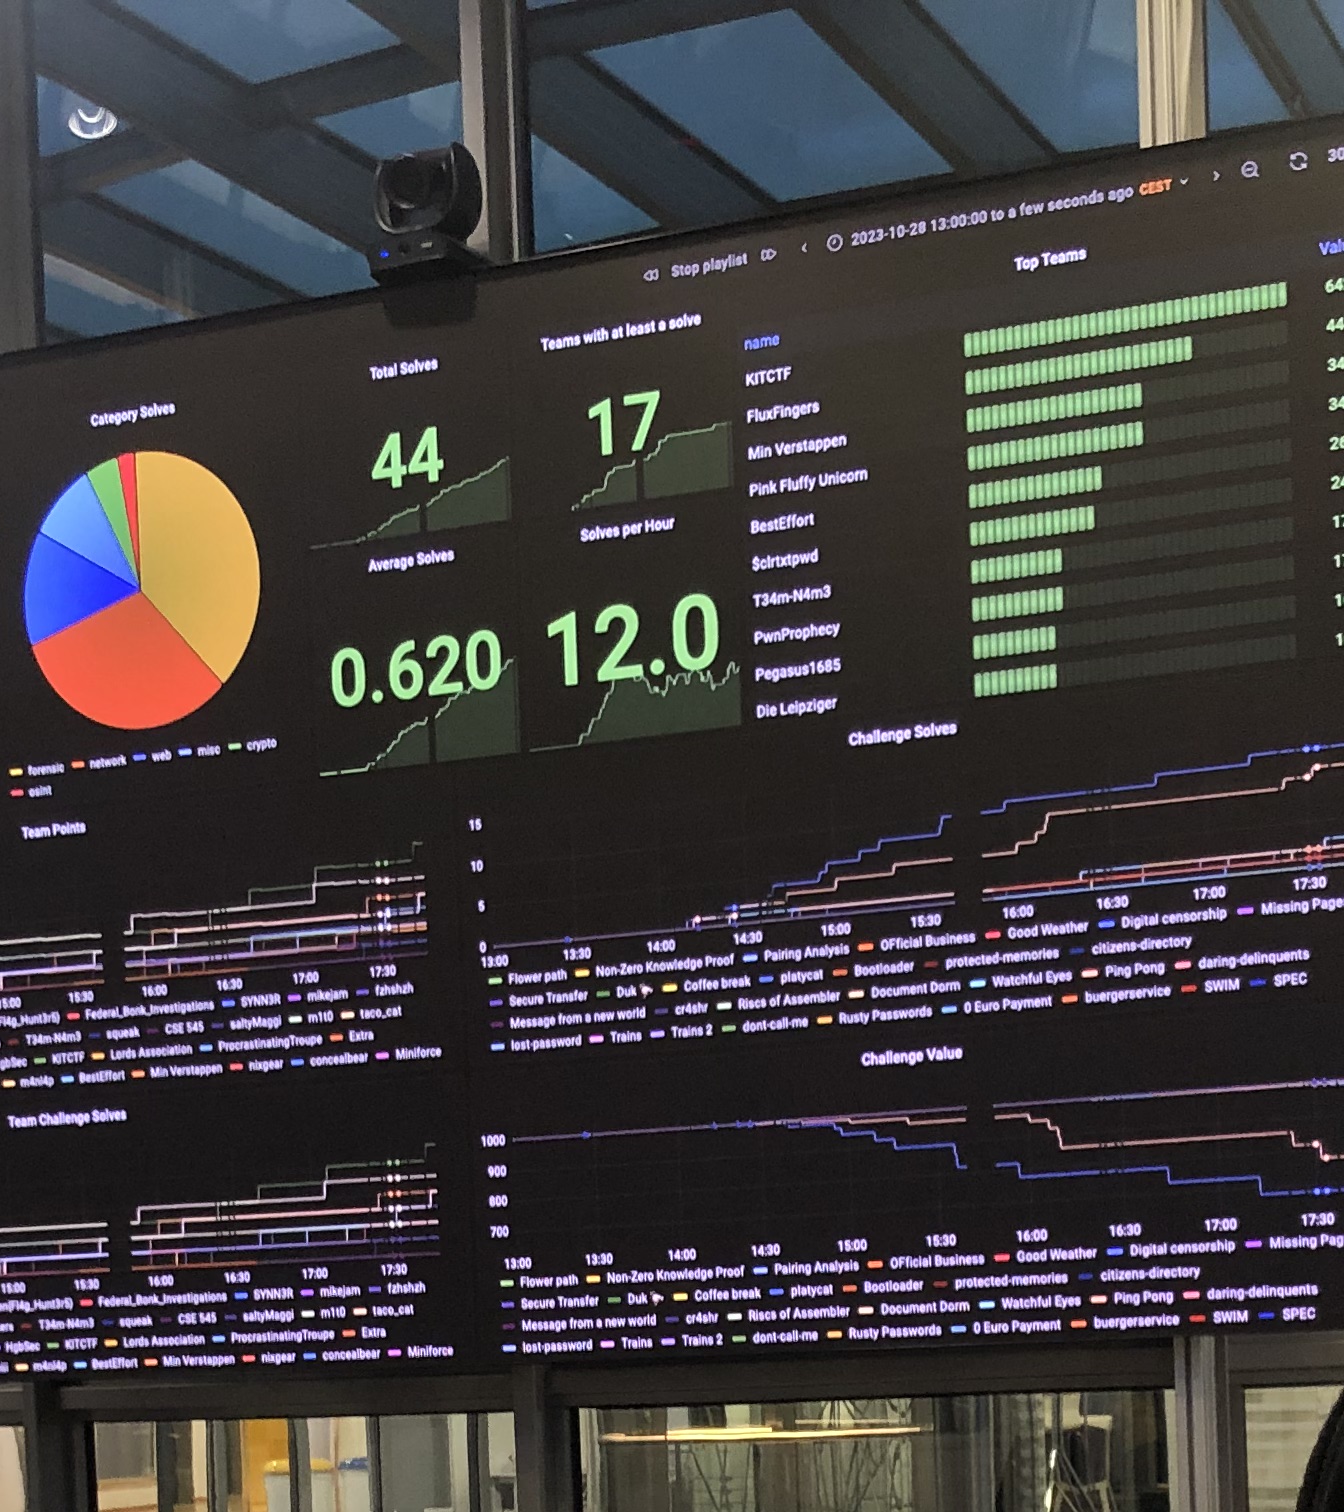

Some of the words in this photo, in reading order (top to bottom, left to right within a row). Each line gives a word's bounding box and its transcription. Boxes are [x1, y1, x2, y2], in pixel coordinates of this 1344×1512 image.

[851, 221, 926, 246] 2023-10-28
[931, 210, 987, 231] 13:00:00
[991, 210, 1004, 221] to
[1008, 207, 1016, 218] a
[1019, 202, 1044, 216] few
[1048, 190, 1104, 211] seconds
[1108, 187, 1134, 202] ago
[1139, 179, 1172, 195] CEST
[671, 264, 699, 277] Stop
[703, 253, 747, 274] playlist
[1014, 257, 1039, 271] Top
[1041, 249, 1086, 266] Teams
[541, 335, 581, 351] Teams
[583, 327, 609, 344] with
[612, 326, 623, 339] at
[626, 320, 656, 337] least
[658, 320, 666, 331] a
[669, 313, 701, 329] solve
[744, 335, 779, 350] name
[370, 363, 397, 380] Total
[400, 359, 438, 375] Solves
[746, 366, 791, 386] KITCTF
[90, 410, 138, 427] Category
[140, 403, 175, 418] Solves
[747, 402, 819, 423] FluxFingers
[588, 389, 660, 457] 17
[371, 425, 445, 489] 44
[748, 446, 772, 460] Min
[775, 435, 847, 456] Verstappen
[749, 480, 777, 497] Pink
[780, 475, 816, 493] Fluffy
[819, 469, 868, 487] Unicorn
[581, 526, 620, 542] Solves
[622, 523, 642, 539] per
[645, 518, 675, 532] Hour
[751, 513, 814, 534] BestEffort
[368, 556, 414, 572] Average
[417, 550, 454, 565] Solves
[753, 584, 831, 607] T34m-N4m3
[546, 593, 719, 687] 12.0
[754, 623, 840, 644] PwnProphecy
[331, 629, 502, 708] 0.620
[755, 658, 841, 682] Pegasus1685
[757, 704, 777, 718] Die
[780, 698, 837, 716] Leipziger
[848, 729, 911, 746] Challenge
[914, 723, 957, 738] Solves
[90, 755, 127, 769] network
[152, 749, 172, 762] web
[247, 738, 277, 752] crypto
[28, 785, 52, 797] osint
[21, 827, 51, 839] Team
[52, 822, 86, 836] Points
[1193, 885, 1226, 900] 17:00
[1293, 876, 1327, 891] 17:30
[1261, 900, 1309, 915] Missing
[1121, 913, 1158, 930] Digital
[1162, 907, 1227, 924] censorship
[1008, 924, 1038, 939] Good
[1041, 921, 1088, 936] Weather
[925, 933, 976, 947] Business
[1092, 936, 1192, 955] citizens-directory
[764, 948, 801, 962] Pairing
[804, 943, 850, 958] Analysis
[946, 948, 1059, 970] protected-memories
[1198, 949, 1310, 969] daring-delinquents
[646, 957, 703, 973] Knowledge
[705, 953, 734, 967] Proof
[854, 961, 914, 977] Bootloader
[1105, 965, 1131, 978] Ping
[1134, 963, 1165, 975] Pong
[508, 973, 542, 985] Flower
[544, 969, 567, 983] path
[684, 978, 719, 992] Coffee
[721, 975, 751, 989] break
[781, 969, 823, 985] platycat
[992, 972, 1042, 987] Watchful
[1045, 971, 1072, 985] Eyes
[1205, 978, 1240, 993] SWIM
[1273, 972, 1307, 987] SPEC
[546, 990, 588, 1003] Transfer
[617, 985, 637, 998] Duk
[769, 994, 781, 1007] of
[783, 990, 840, 1006] Assembler
[871, 983, 927, 998] Document
[930, 981, 961, 993] Dorm
[1085, 985, 1171, 1003] buergerservice
[974, 1001, 1000, 1013] Euro
[1002, 995, 1052, 1011] Payment
[510, 1016, 556, 1029] Message
[558, 1013, 582, 1025] from
[585, 1013, 591, 1023] a
[594, 1011, 615, 1022] new
[618, 1006, 646, 1020] world
[839, 1012, 869, 1024] Rusty
[872, 1005, 932, 1021] Passwords
[349, 1030, 374, 1042] Extra
[610, 1031, 642, 1043] Trains
[671, 1025, 703, 1038] Trains
[706, 1024, 712, 1036] 2
[396, 1047, 441, 1060] Miniforce
[861, 1050, 924, 1066] Challenge
[926, 1046, 963, 1061] Value
[7, 1116, 37, 1128] Team
[38, 1112, 90, 1126] Challenge
[91, 1108, 127, 1123] Solves
[481, 1134, 505, 1147] 1000
